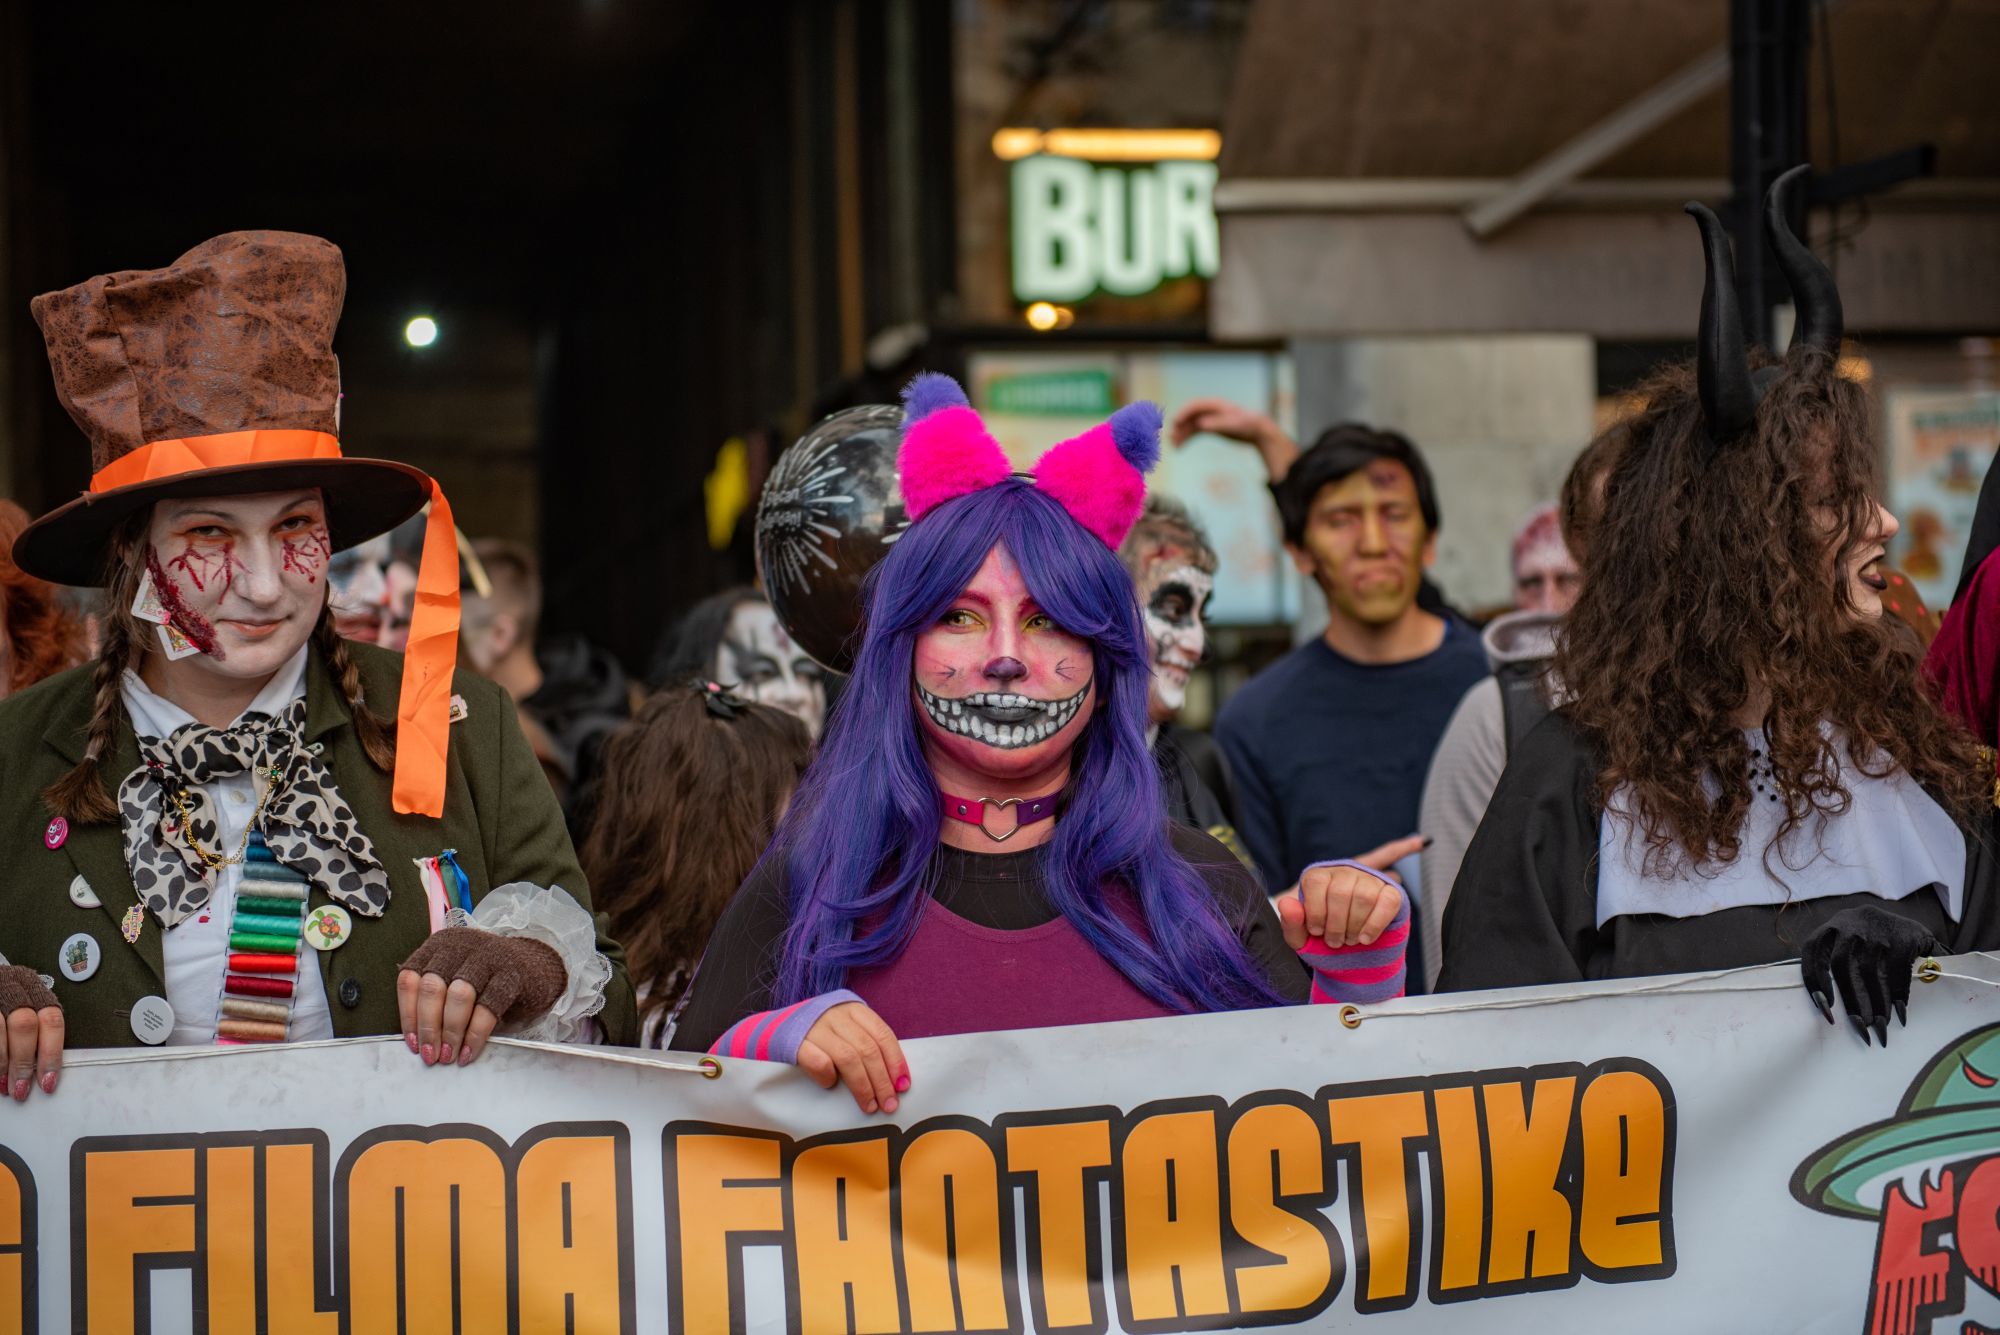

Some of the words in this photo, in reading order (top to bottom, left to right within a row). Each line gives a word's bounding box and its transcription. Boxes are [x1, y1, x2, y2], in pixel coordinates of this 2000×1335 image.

[1011, 155, 1220, 301] BUR
[69, 1121, 635, 1335] FILMA
[662, 1057, 1677, 1335] FANTASTIKE
